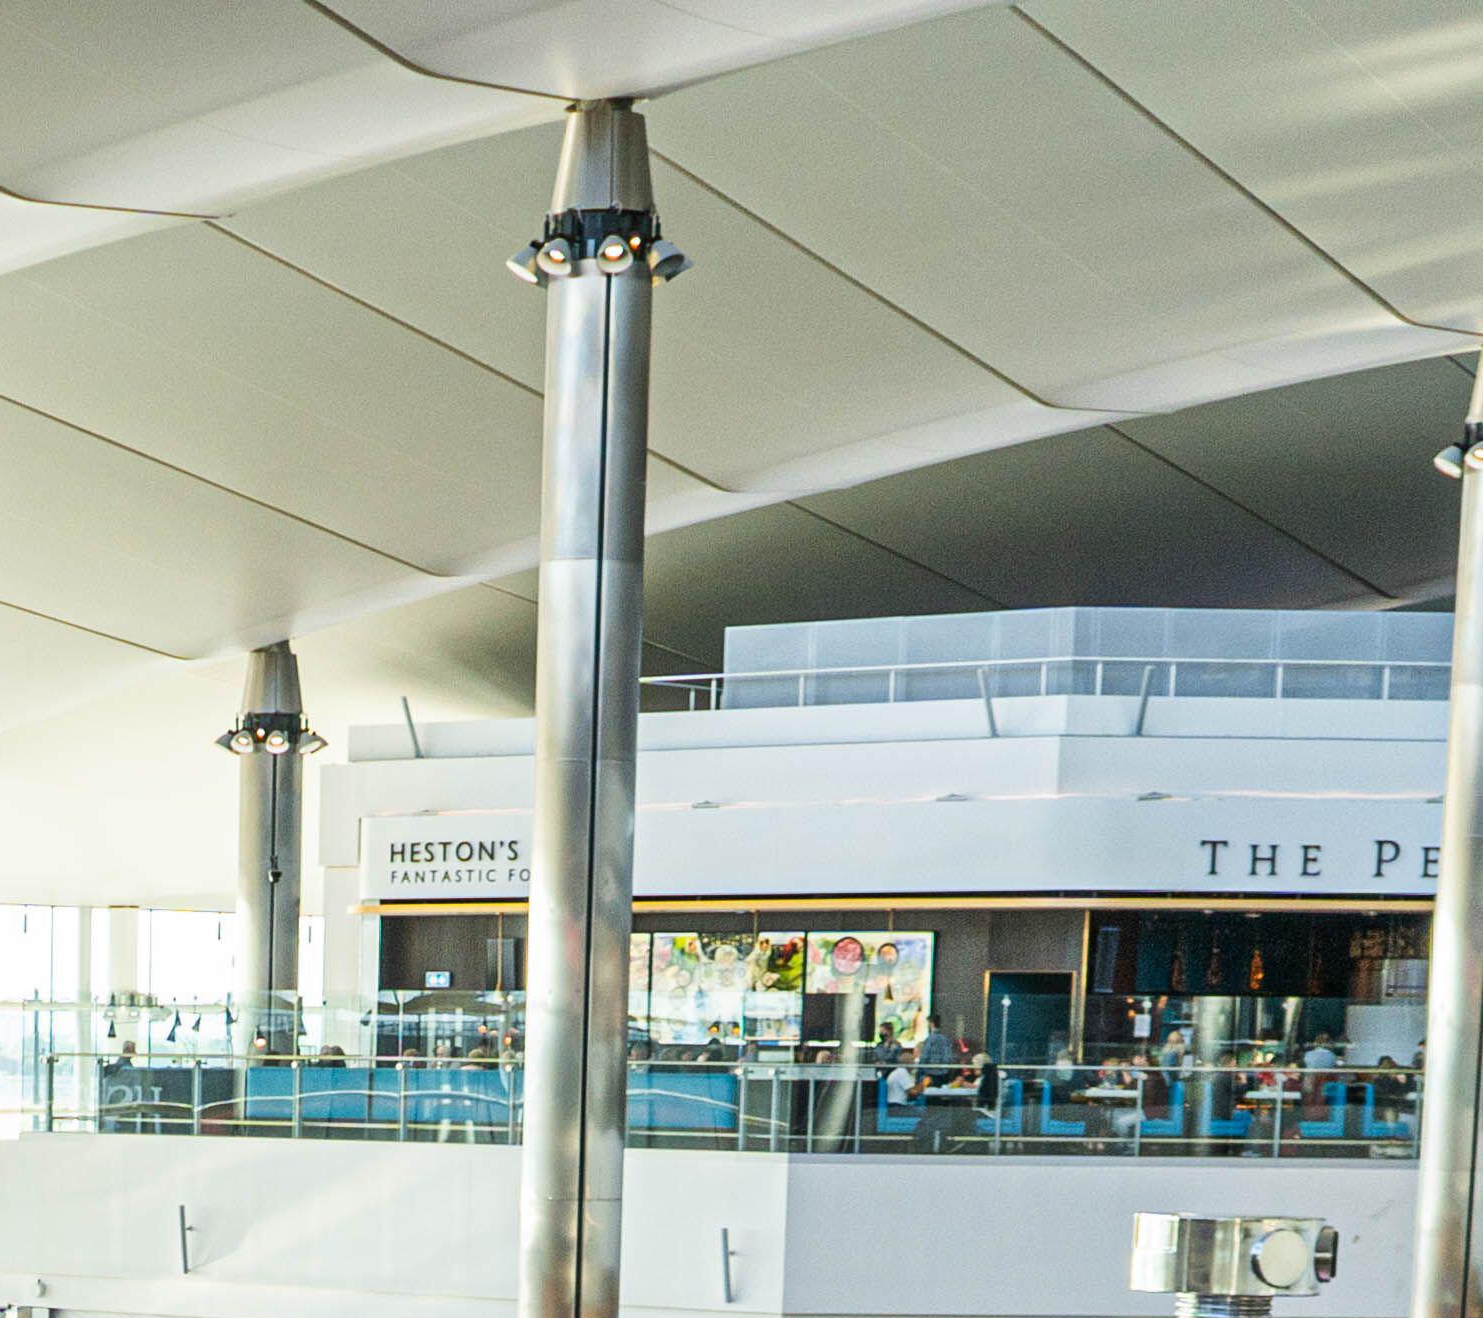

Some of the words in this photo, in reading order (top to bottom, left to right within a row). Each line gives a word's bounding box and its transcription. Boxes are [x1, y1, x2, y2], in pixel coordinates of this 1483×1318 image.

[390, 840, 518, 862] HESTON'S
[1200, 840, 1322, 877] THE
[390, 869, 496, 883] FANTASTIC
[508, 868, 531, 883] FO
